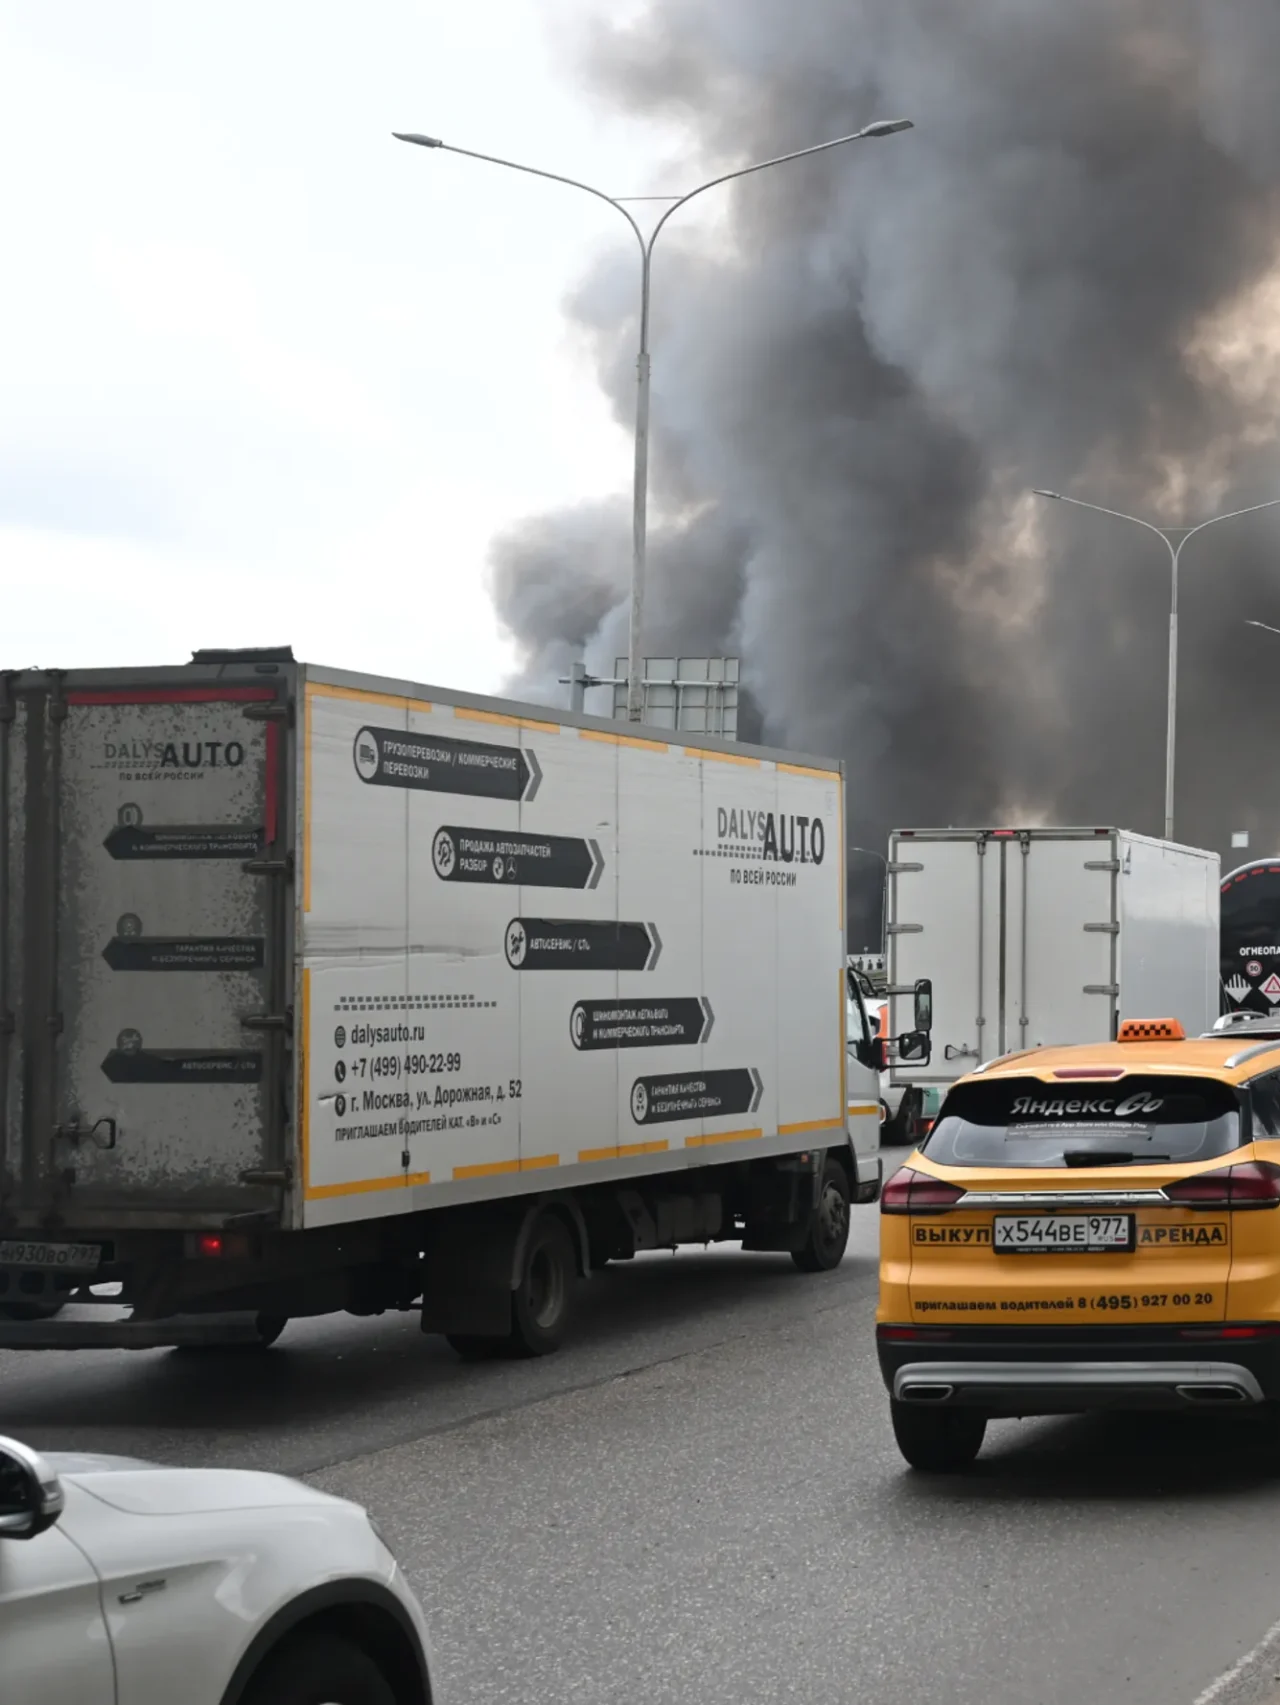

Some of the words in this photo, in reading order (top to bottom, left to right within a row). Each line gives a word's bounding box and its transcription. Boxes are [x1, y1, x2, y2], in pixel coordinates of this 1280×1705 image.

[383, 741, 451, 763] ГРУЗОПЕРЕВОЗКИ
[458, 753, 517, 770] КОММЕРЧЕСКИЕ
[119, 772, 132, 780] ПО
[135, 772, 161, 780] ВСЕЙ
[164, 772, 204, 780] РОССИИ
[383, 761, 430, 779] ПЕРЕВОЗКИ
[460, 839, 495, 853] ПРОДАЖА
[496, 841, 551, 858] АВТОЗАПЧАСТЕЙ
[460, 858, 488, 871] РАЗБОР
[730, 869, 742, 884] ПО
[743, 867, 764, 884] ВСЕЙ
[766, 871, 797, 886] РОССИИ
[530, 938, 573, 950] АВТОСЕРВИС
[351, 1023, 425, 1047] dalysauto.ru
[351, 1058, 367, 1078] +7
[369, 1055, 401, 1081] (499)
[404, 1052, 461, 1074] 490-22-99
[350, 1096, 359, 1112] г.
[362, 1090, 414, 1111] Москва,
[416, 1090, 432, 1110] ул.
[433, 1085, 494, 1108] Дорожная,
[496, 1085, 506, 1102] д.
[509, 1079, 522, 1098] 52
[1010, 1096, 1115, 1116] Яндекс
[1115, 1092, 1164, 1116] Go
[335, 1122, 397, 1141] ПРИГЛАШАЕМ
[398, 1114, 447, 1135] ВОДИТЕЛЕЙ
[448, 1116, 465, 1129] КАТ.
[915, 1228, 990, 1243] ВЫКУП
[1090, 1217, 1123, 1235] 977
[1141, 1227, 1222, 1244] АРЕНДА
[915, 1301, 997, 1312] приглашаем
[1001, 1299, 1074, 1311] водителей
[1078, 1298, 1086, 1308] 8
[1091, 1296, 1138, 1310] (495)
[1141, 1295, 1169, 1306] 927
[1172, 1294, 1191, 1305] 00
[1195, 1293, 1213, 1304] 20
